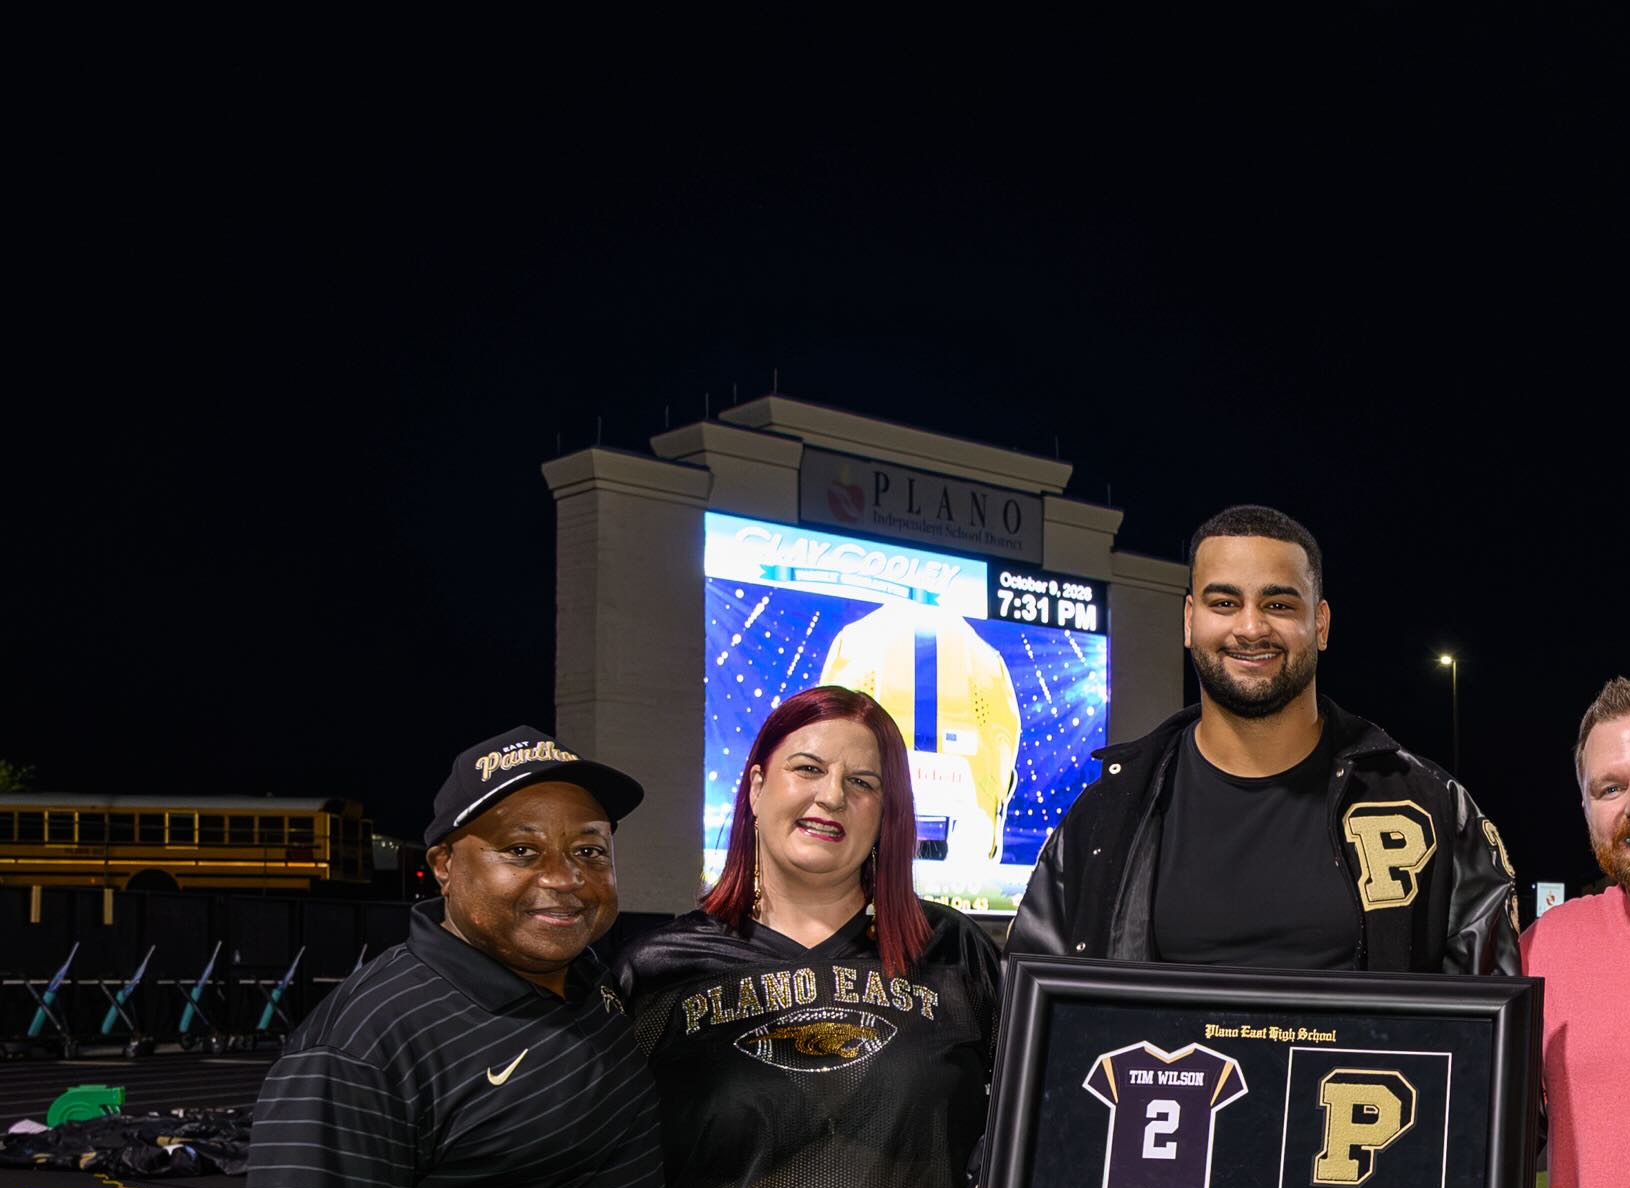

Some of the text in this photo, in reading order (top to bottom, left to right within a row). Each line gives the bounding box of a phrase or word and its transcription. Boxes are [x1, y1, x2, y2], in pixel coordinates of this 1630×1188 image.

[872, 471, 1022, 535] PLANO
[999, 571, 1048, 594] October
[997, 589, 1097, 632] 7:31 PM
[502, 740, 529, 753] EAST
[1343, 799, 1438, 912] P
[682, 965, 940, 1036] PLANO EAST
[1204, 1024, 1337, 1044] Plano East High School
[1129, 1070, 1205, 1087] TIM WILSON
[1142, 1099, 1181, 1160] 2
[1313, 1068, 1417, 1185] P
